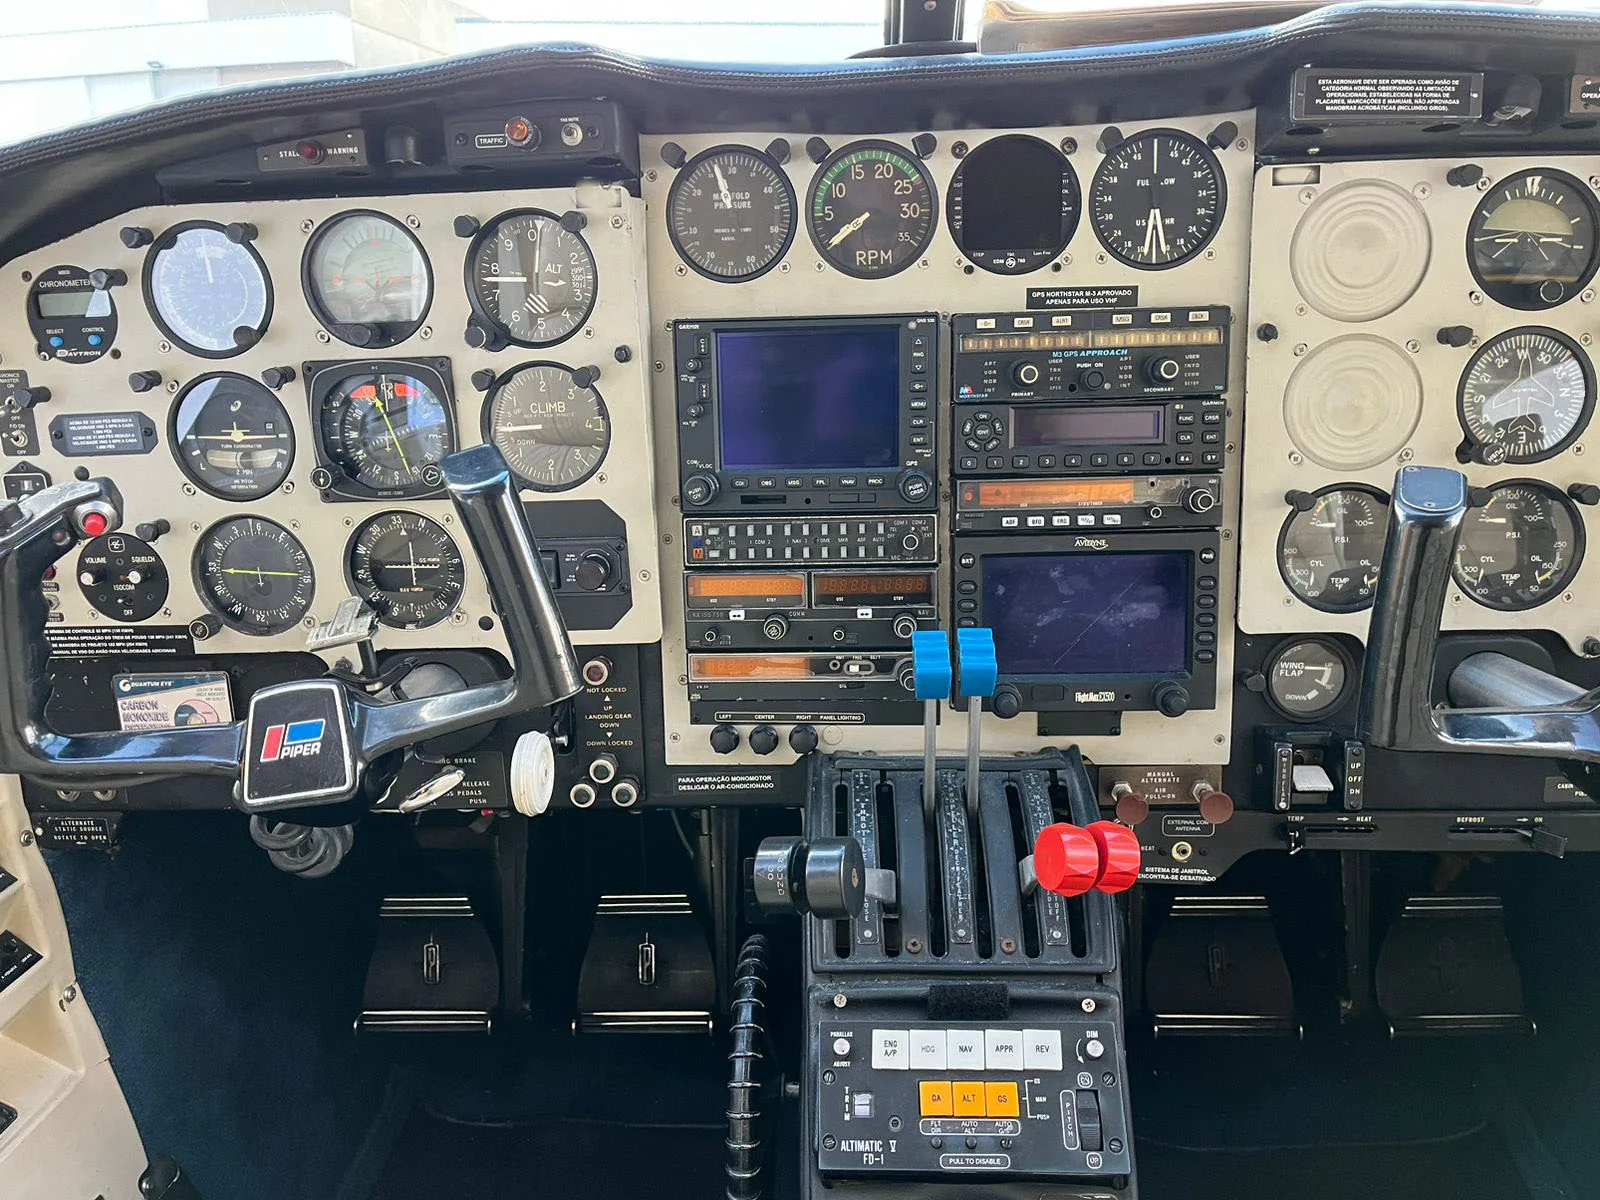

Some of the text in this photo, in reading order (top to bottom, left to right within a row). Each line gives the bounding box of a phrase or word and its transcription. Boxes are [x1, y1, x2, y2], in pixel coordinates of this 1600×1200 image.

[327, 146, 358, 155] WARNING
[727, 166, 737, 175] 30
[851, 164, 865, 180] 15
[874, 163, 894, 179] 20
[763, 186, 773, 194] 40
[832, 183, 846, 198] 10
[894, 180, 913, 195] 25
[824, 206, 834, 221] 5
[900, 203, 920, 218] 30
[1196, 207, 1206, 215] 30
[769, 225, 779, 234] 50
[898, 232, 911, 242] 35
[856, 249, 893, 266] RPM
[545, 263, 563, 274] ALT
[39, 279, 92, 288] CHRONOMETE
[56, 349, 101, 358] DAVTRON
[530, 402, 566, 413] CLIMB
[1310, 559, 1324, 567] CYL
[121, 700, 160, 711] CARBON
[122, 712, 170, 723] MONOXIDE
[281, 742, 321, 759] PIPER
[695, 776, 729, 784] OPERAÇÃO
[1086, 1030, 1098, 1038] DIM
[884, 1040, 897, 1048] ENG
[921, 1045, 1050, 1053] HDG NAV APPR REV
[884, 1048, 897, 1057] A/P
[997, 1095, 1008, 1103] GS
[1065, 1102, 1073, 1137] PITCH
[840, 1139, 883, 1153] ALTIMATIC
